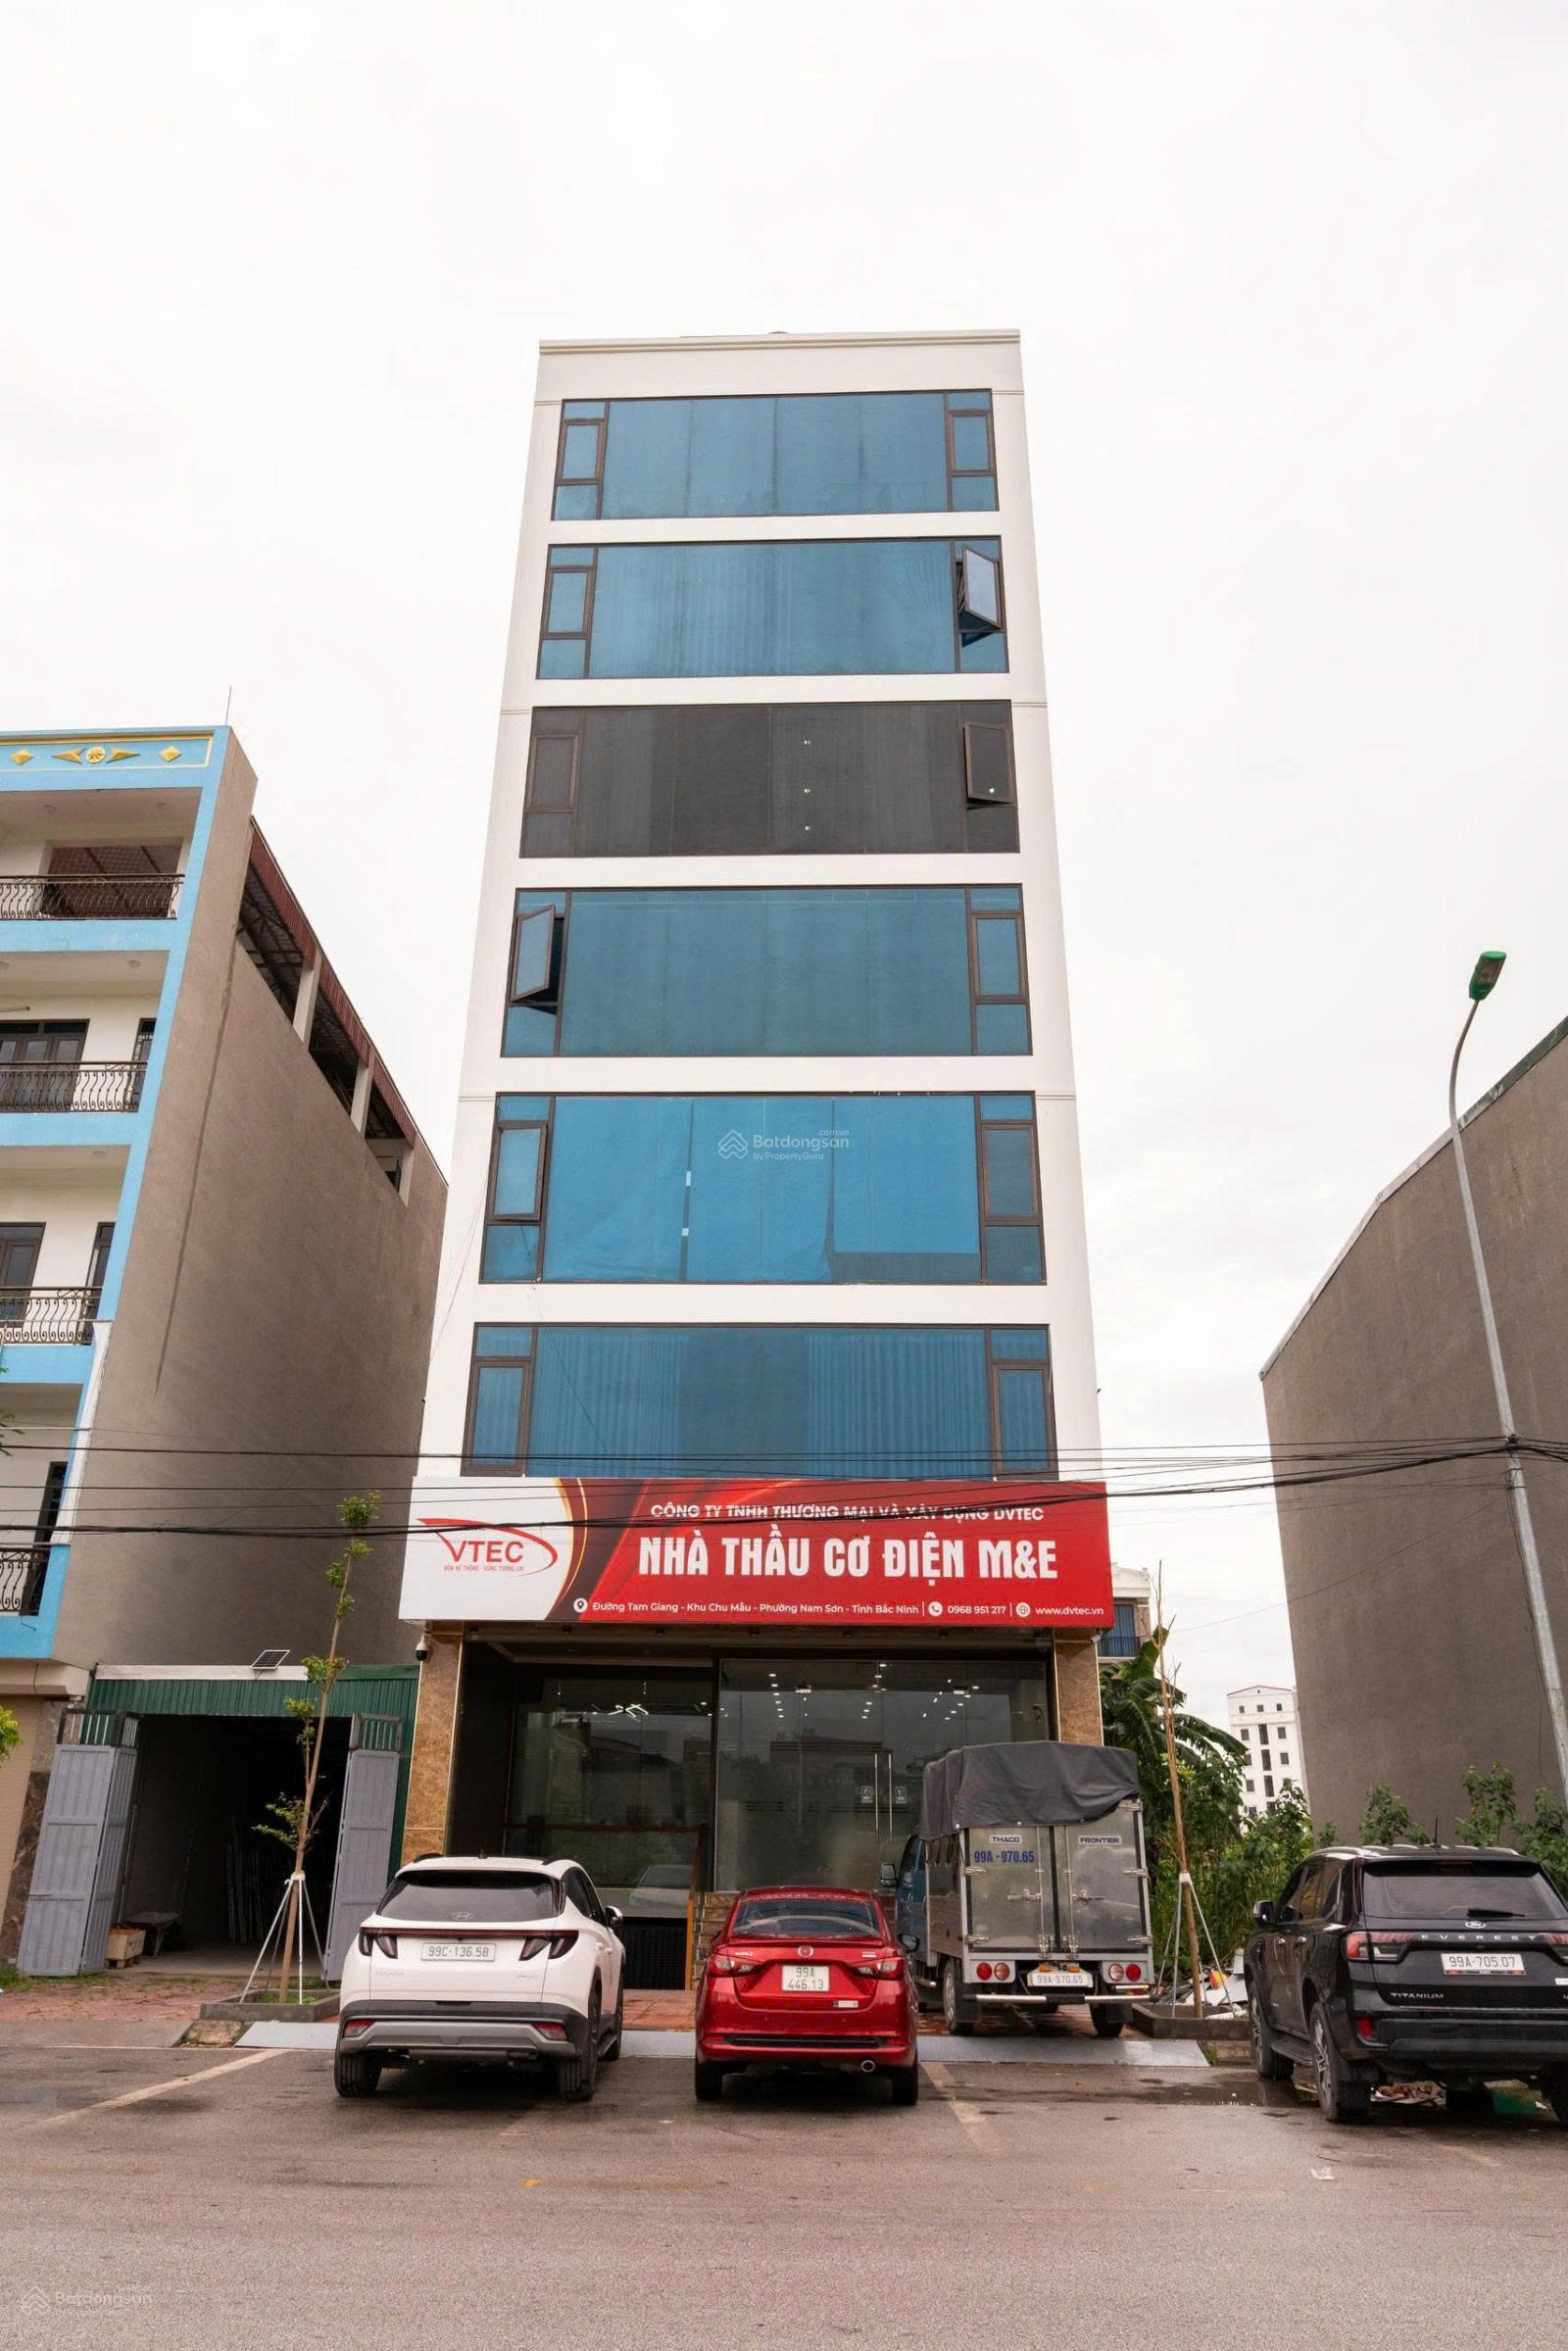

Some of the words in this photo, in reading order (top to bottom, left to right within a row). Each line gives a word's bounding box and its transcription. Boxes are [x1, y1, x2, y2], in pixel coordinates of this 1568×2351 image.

[651, 1501, 700, 1517] CÔNG
[705, 1504, 722, 1518] TY
[726, 1504, 768, 1518] TNHH
[772, 1503, 840, 1518] THƯƠNG
[994, 1507, 1045, 1521] DVTEC
[639, 1530, 709, 1576] NHÀ
[721, 1523, 810, 1577] THẦU
[823, 1536, 870, 1577] CƠ
[882, 1532, 965, 1587] ĐIỆN
[979, 1540, 1058, 1579] M&E
[592, 1601, 625, 1612] Đường
[627, 1602, 649, 1612] Tam
[651, 1601, 679, 1613] Giang
[687, 1602, 707, 1612] Khu
[709, 1602, 728, 1612] Chu
[730, 1601, 752, 1612] Mẫu
[760, 1602, 798, 1614] Phường
[800, 1603, 822, 1613] Nam
[825, 1603, 844, 1613] Sơn
[875, 1603, 894, 1614] Bắc
[896, 1604, 919, 1614] Ninh
[947, 1605, 972, 1615] 0968
[974, 1605, 990, 1615] 951
[991, 1605, 1006, 1615] 217
[1035, 1605, 1104, 1616] www.dvtec.vn
[974, 1850, 994, 1863] 99A
[1002, 1850, 1036, 1863] 970.65
[1448, 1956, 1516, 1968] 99A-705.07
[796, 1967, 815, 1978] 99A
[788, 1980, 824, 1990] 446.13
